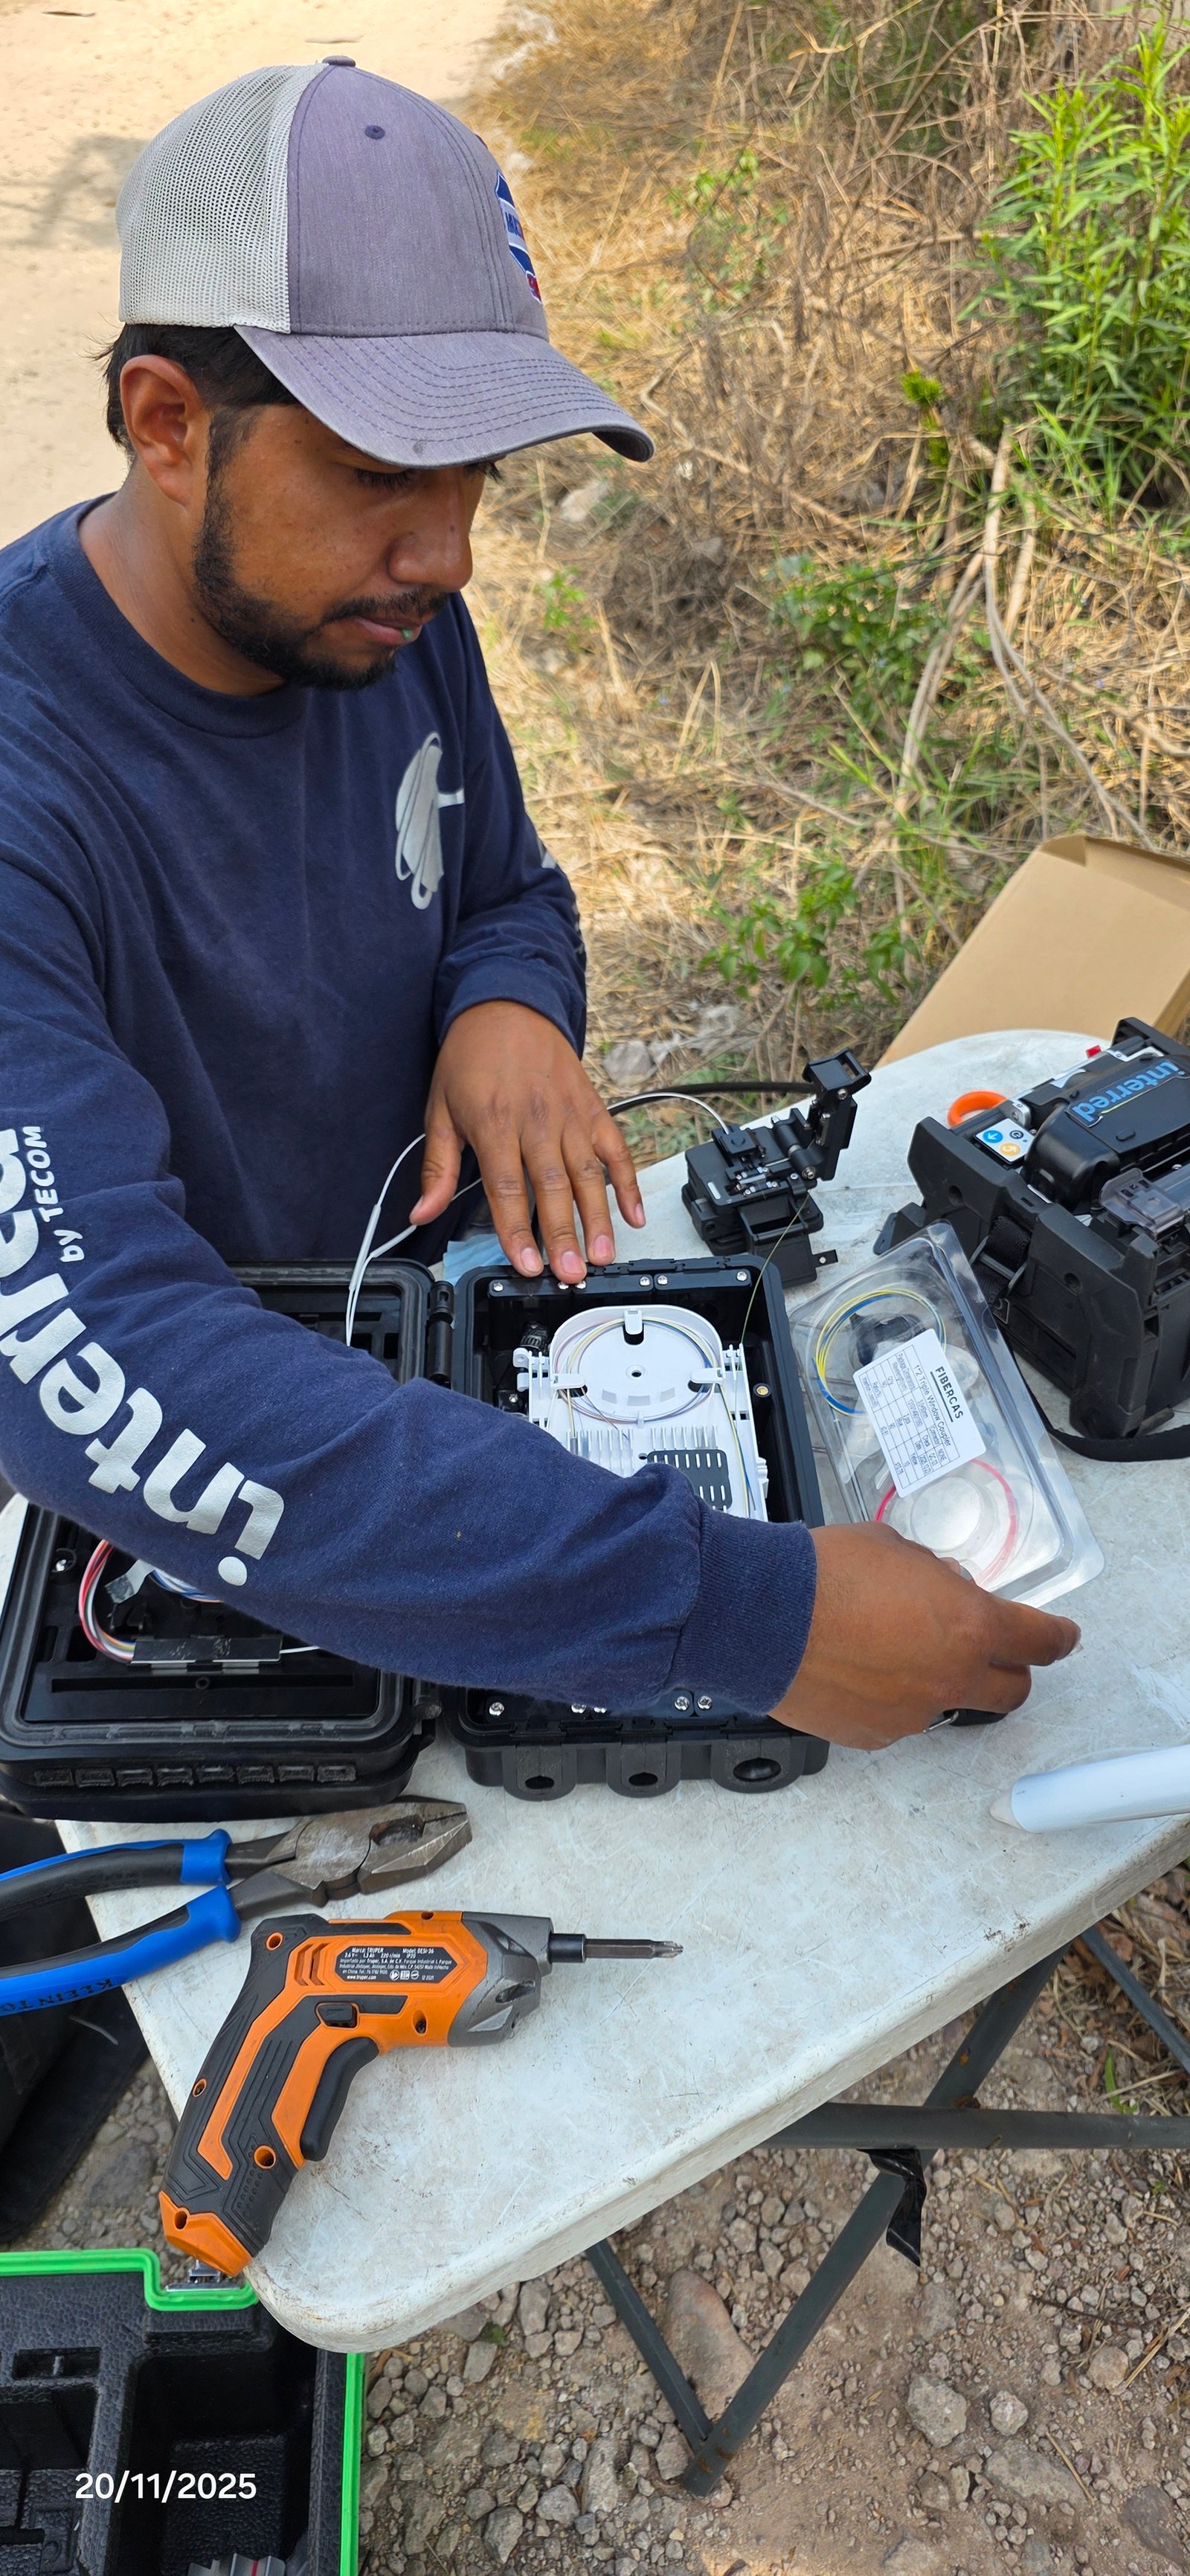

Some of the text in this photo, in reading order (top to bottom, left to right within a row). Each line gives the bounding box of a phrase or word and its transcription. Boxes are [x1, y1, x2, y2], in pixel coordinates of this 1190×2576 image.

[1072, 1061, 1185, 1122] interred
[22, 1126, 85, 1262] by TECOM
[916, 1376, 930, 1396] Triple
[926, 1395, 942, 1421] Window
[935, 1421, 952, 1447] Coupler
[934, 1365, 964, 1419] FIBERCAS
[910, 1452, 919, 1465] Yellow
[914, 1440, 922, 1450] Date
[936, 1448, 947, 1462] NONE
[38, 1979, 112, 2005] KLEIN
